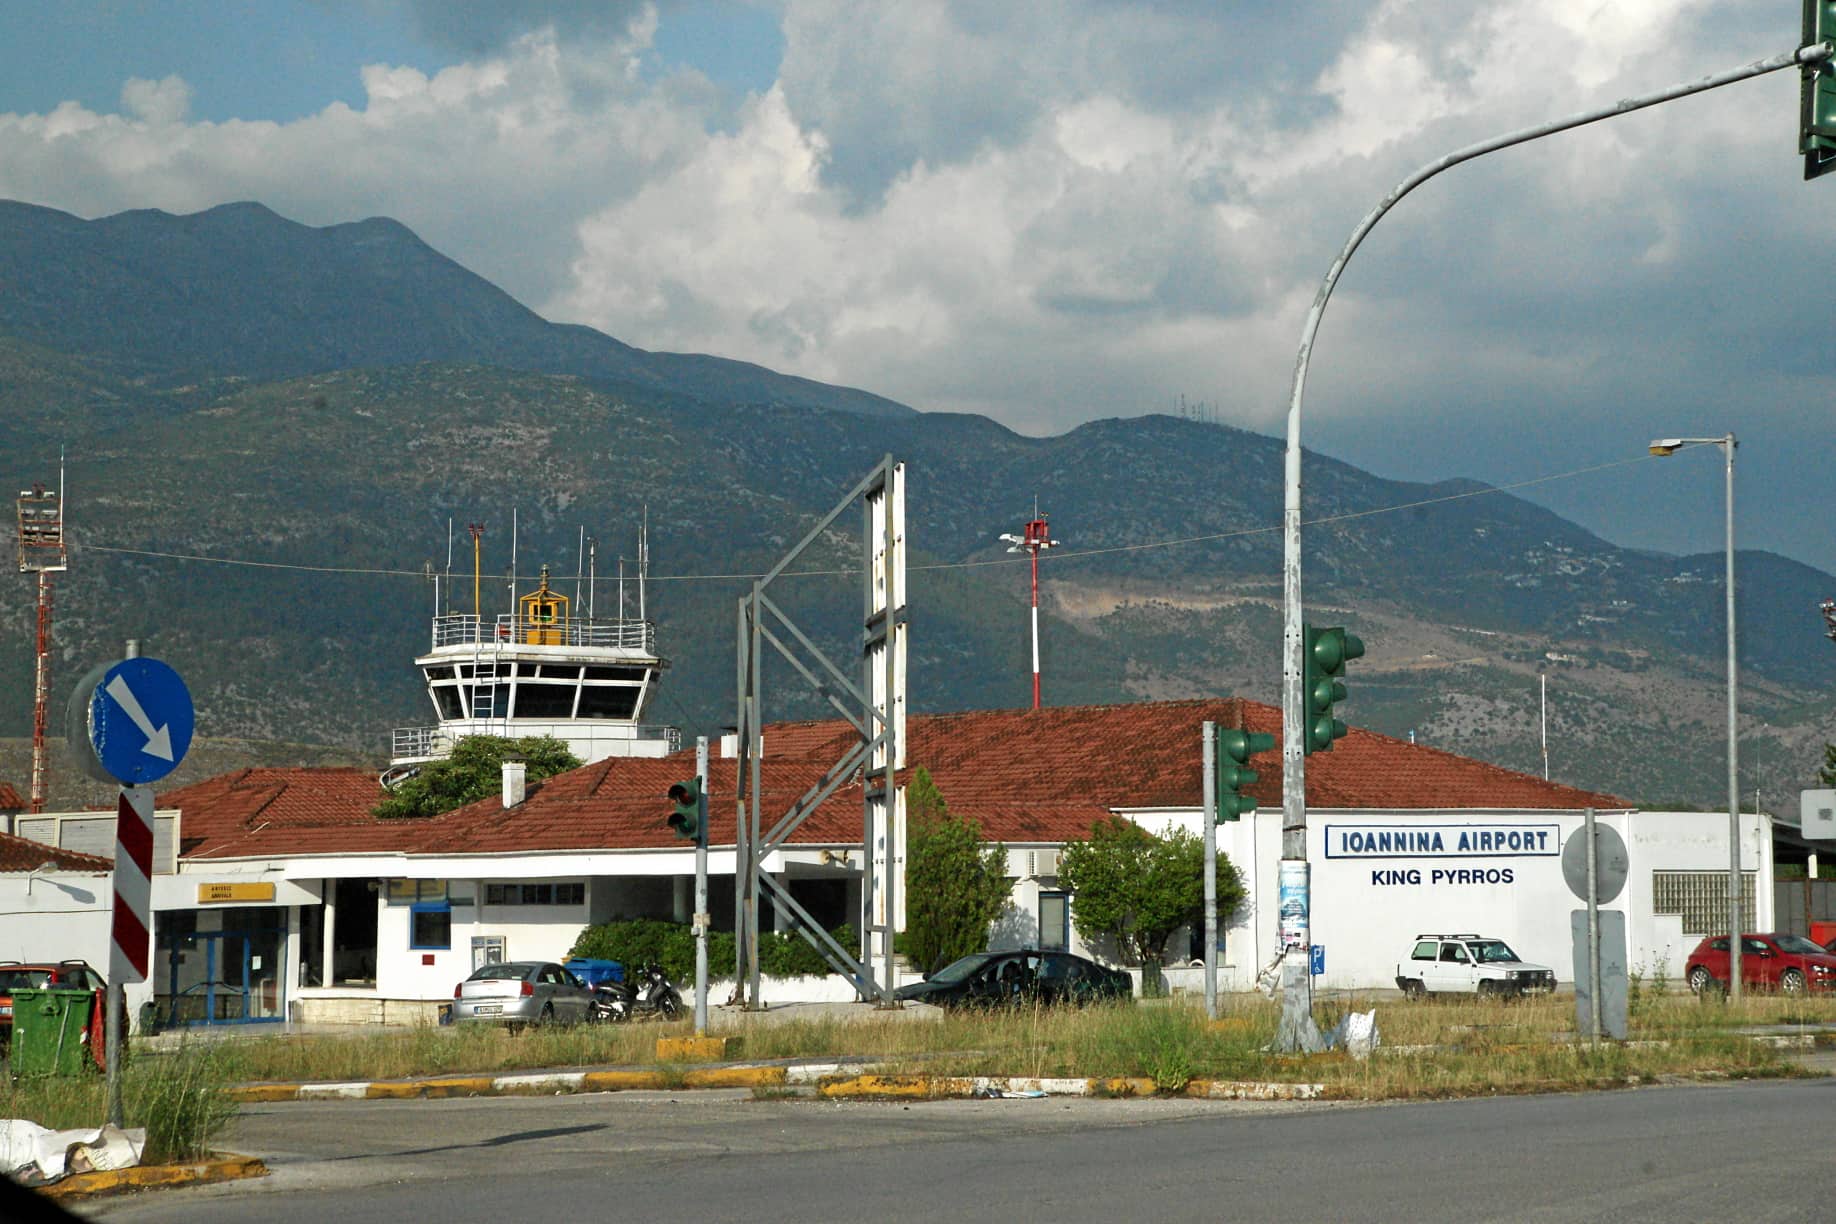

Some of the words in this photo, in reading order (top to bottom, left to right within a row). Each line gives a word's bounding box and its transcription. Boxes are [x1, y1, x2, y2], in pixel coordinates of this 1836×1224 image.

[1342, 831, 1445, 853] IOANNINA
[1457, 831, 1548, 852] AIRPORT
[1371, 869, 1422, 886] KING
[1431, 868, 1514, 885] PYRROS
[1314, 948, 1322, 963] P
